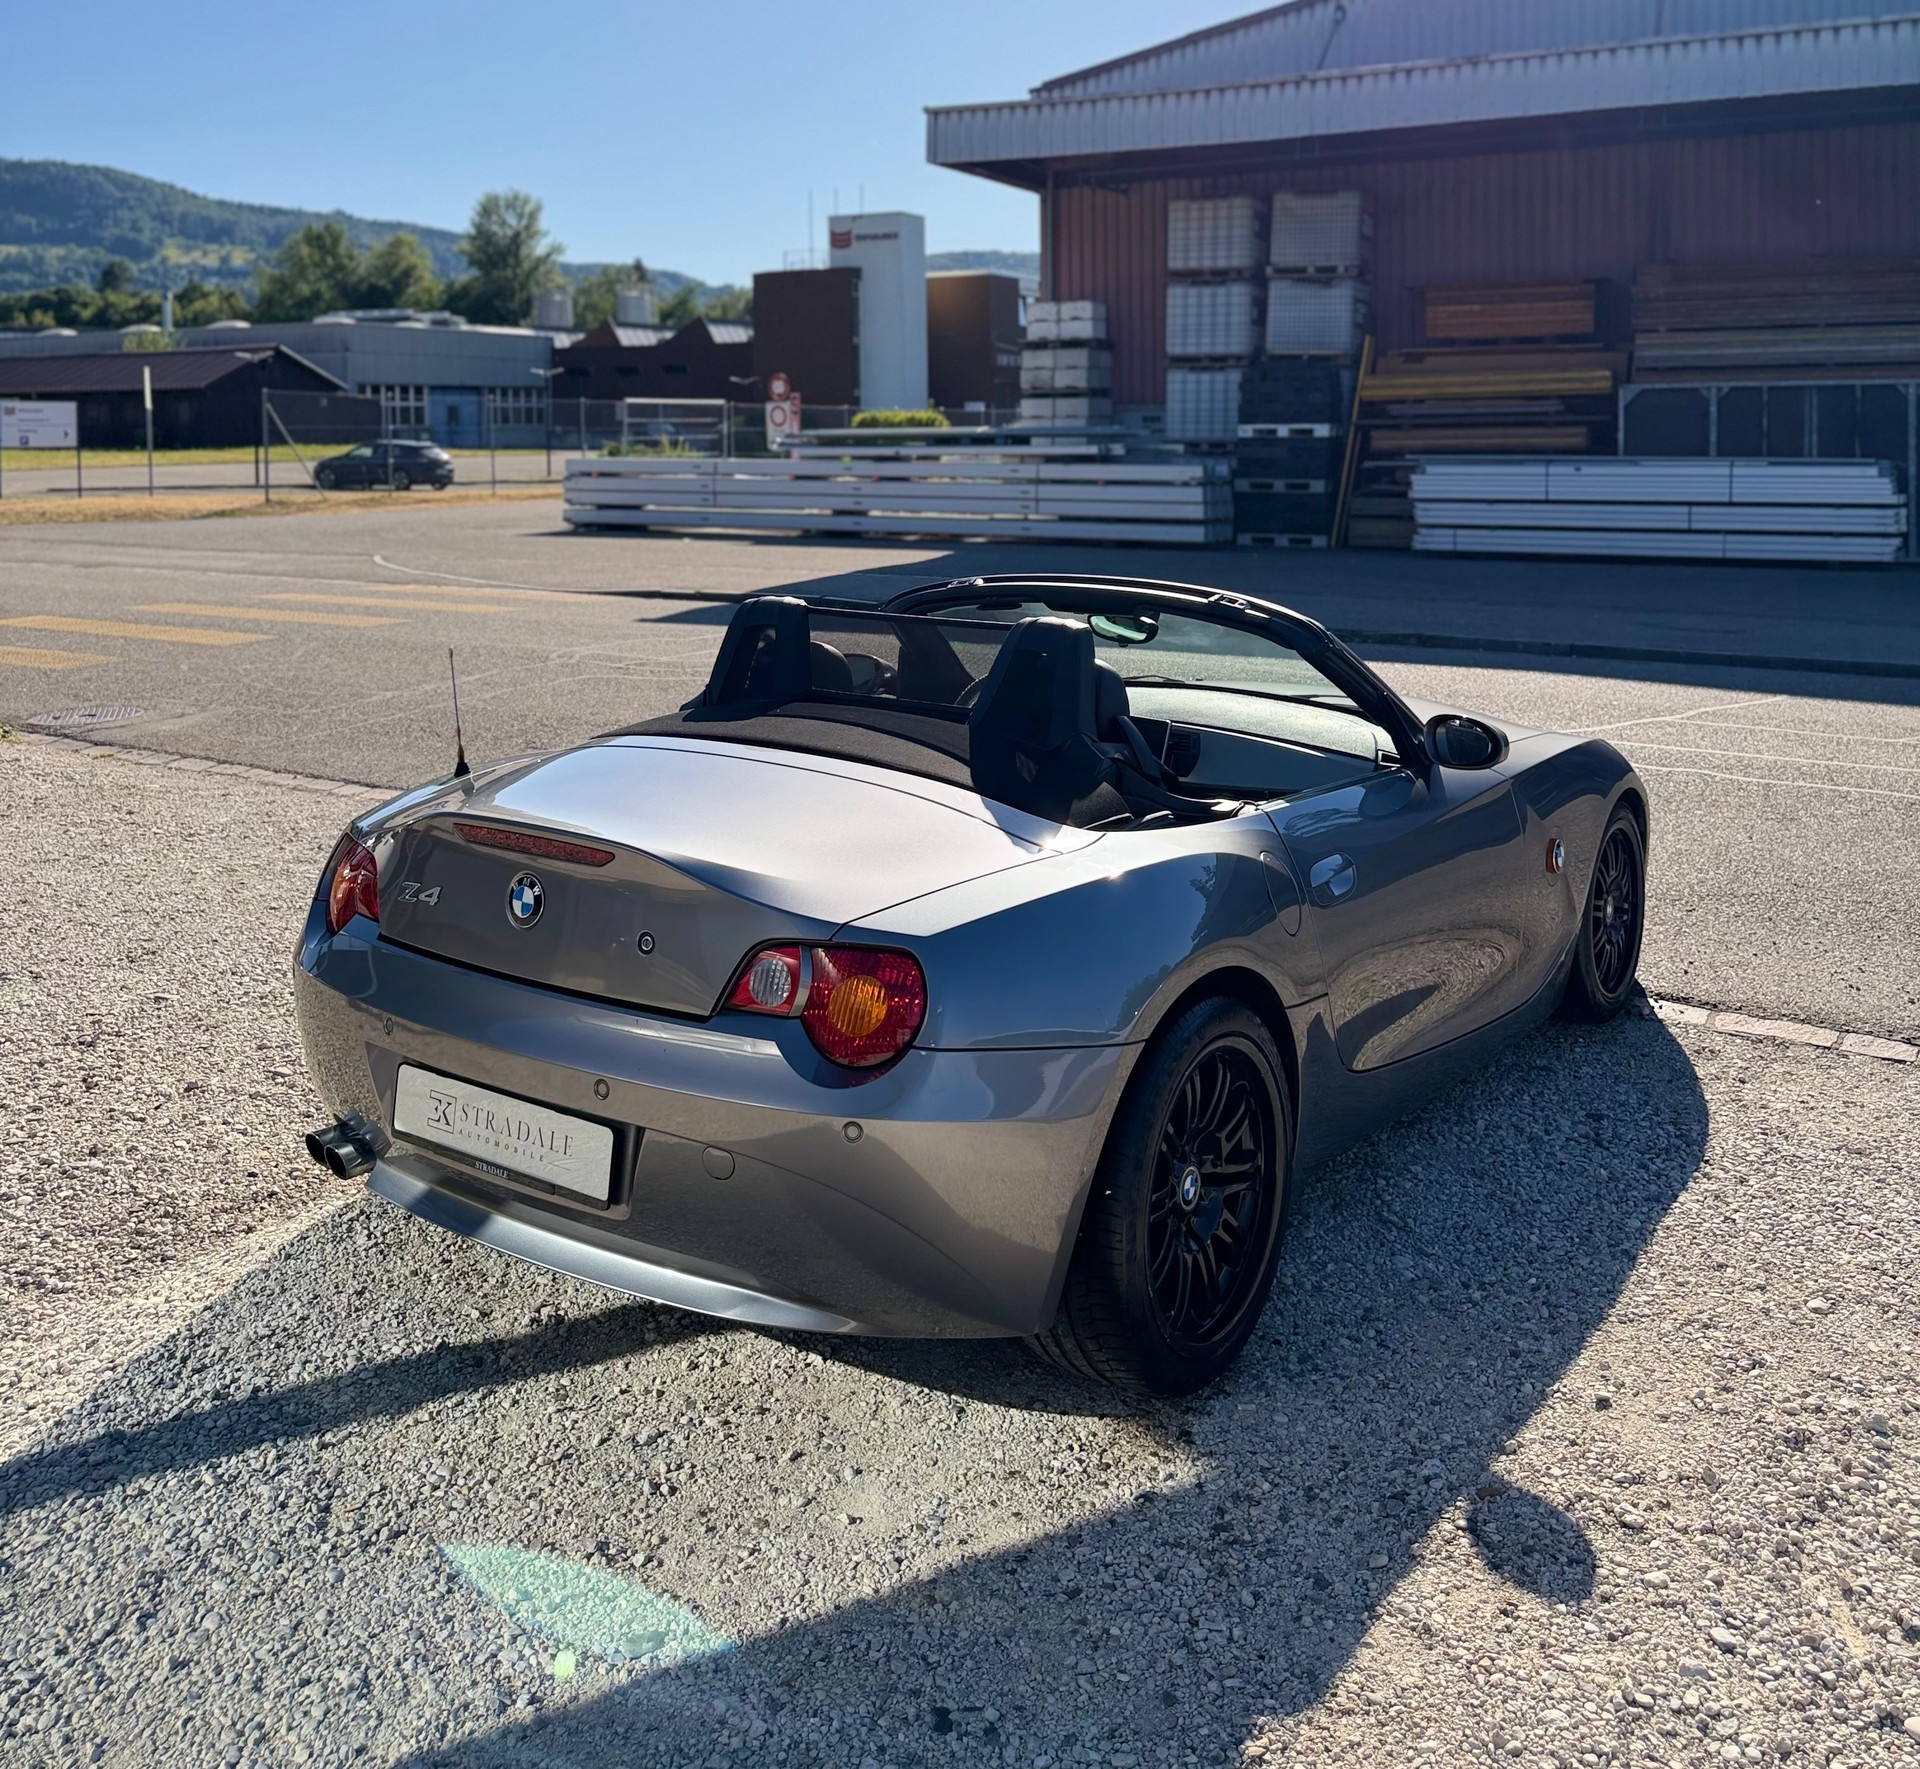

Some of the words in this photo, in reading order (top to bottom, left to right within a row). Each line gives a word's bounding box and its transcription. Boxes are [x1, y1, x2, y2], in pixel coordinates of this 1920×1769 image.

[398, 881, 442, 906] Z4
[513, 877, 541, 896] BMW
[459, 1102, 575, 1157] STRADALE
[458, 1128, 544, 1162] AUTOMOBILE
[475, 1161, 509, 1178] STRADALE
